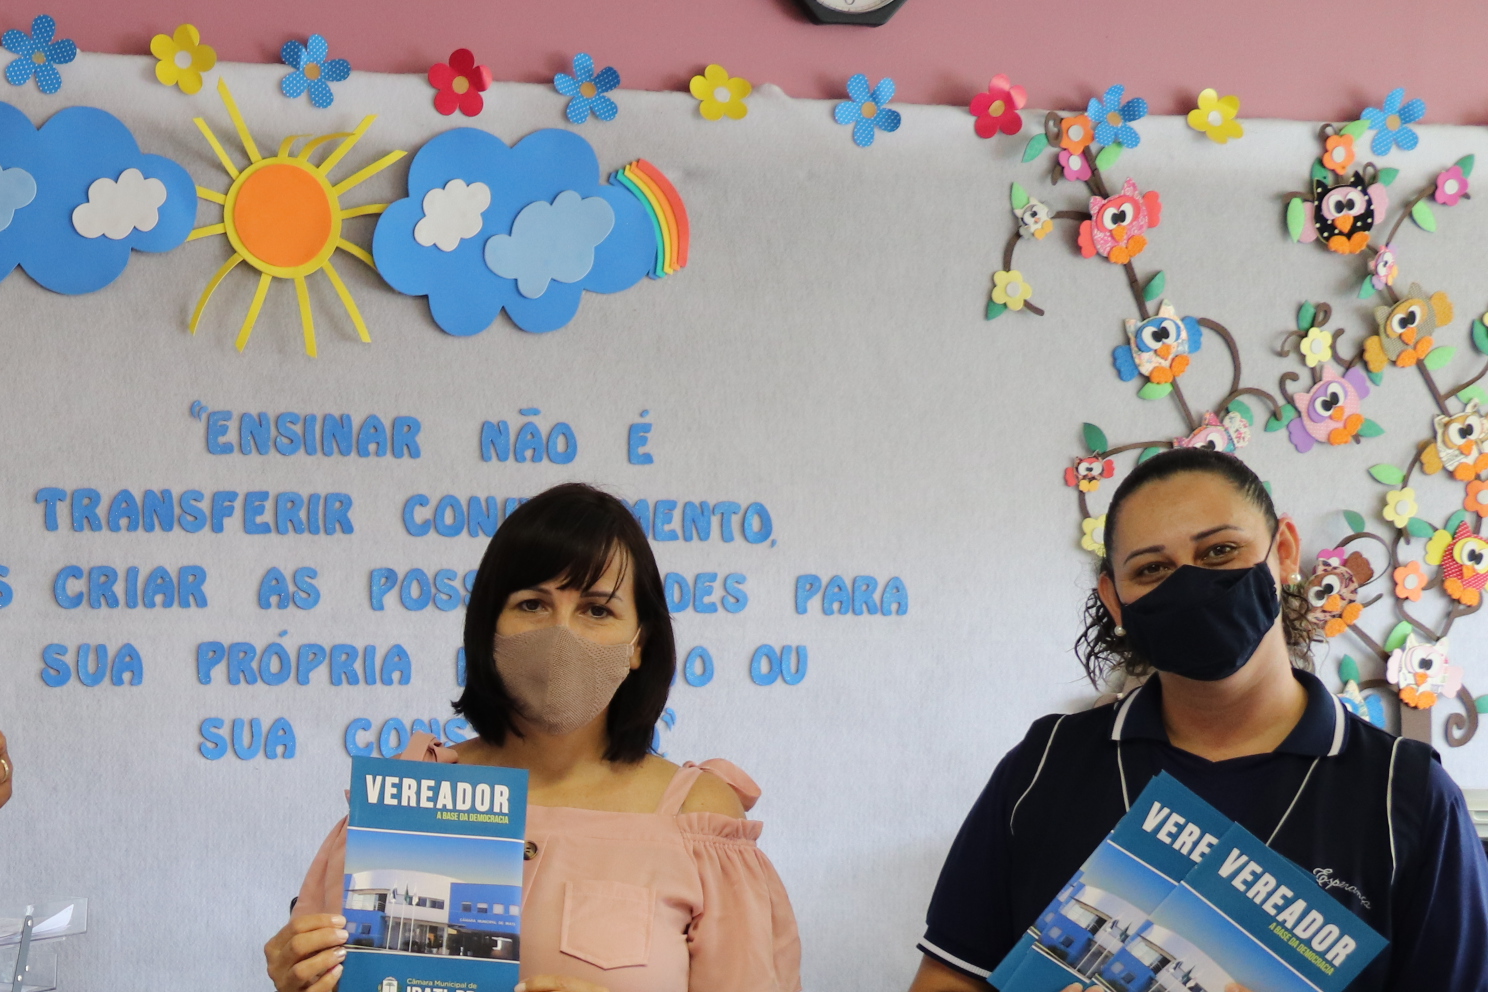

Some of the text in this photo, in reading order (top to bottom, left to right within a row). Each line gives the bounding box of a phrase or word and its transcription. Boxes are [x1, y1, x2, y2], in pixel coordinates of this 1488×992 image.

[481, 407, 578, 465] NÃO
[628, 409, 654, 465] É
[35, 487, 354, 536] TRANSFERIR
[53, 565, 208, 609] CRIAR
[258, 566, 321, 610] AS
[795, 573, 909, 616] PARA
[40, 642, 144, 687] SUA
[197, 629, 412, 686] PRÓPRIA
[750, 643, 809, 687] OU
[199, 716, 296, 760] SUA
[365, 774, 509, 813] VEREADOR
[442, 811, 459, 820] BASE
[459, 812, 468, 821] DA
[469, 813, 509, 824] DEMOCRACIA
[1141, 800, 1220, 863] VERE
[1217, 847, 1357, 967] VEREADOR
[1273, 925, 1292, 941] BASE
[1288, 937, 1300, 948] DA
[406, 978, 433, 986] Câmara
[434, 980, 467, 988] Municipal
